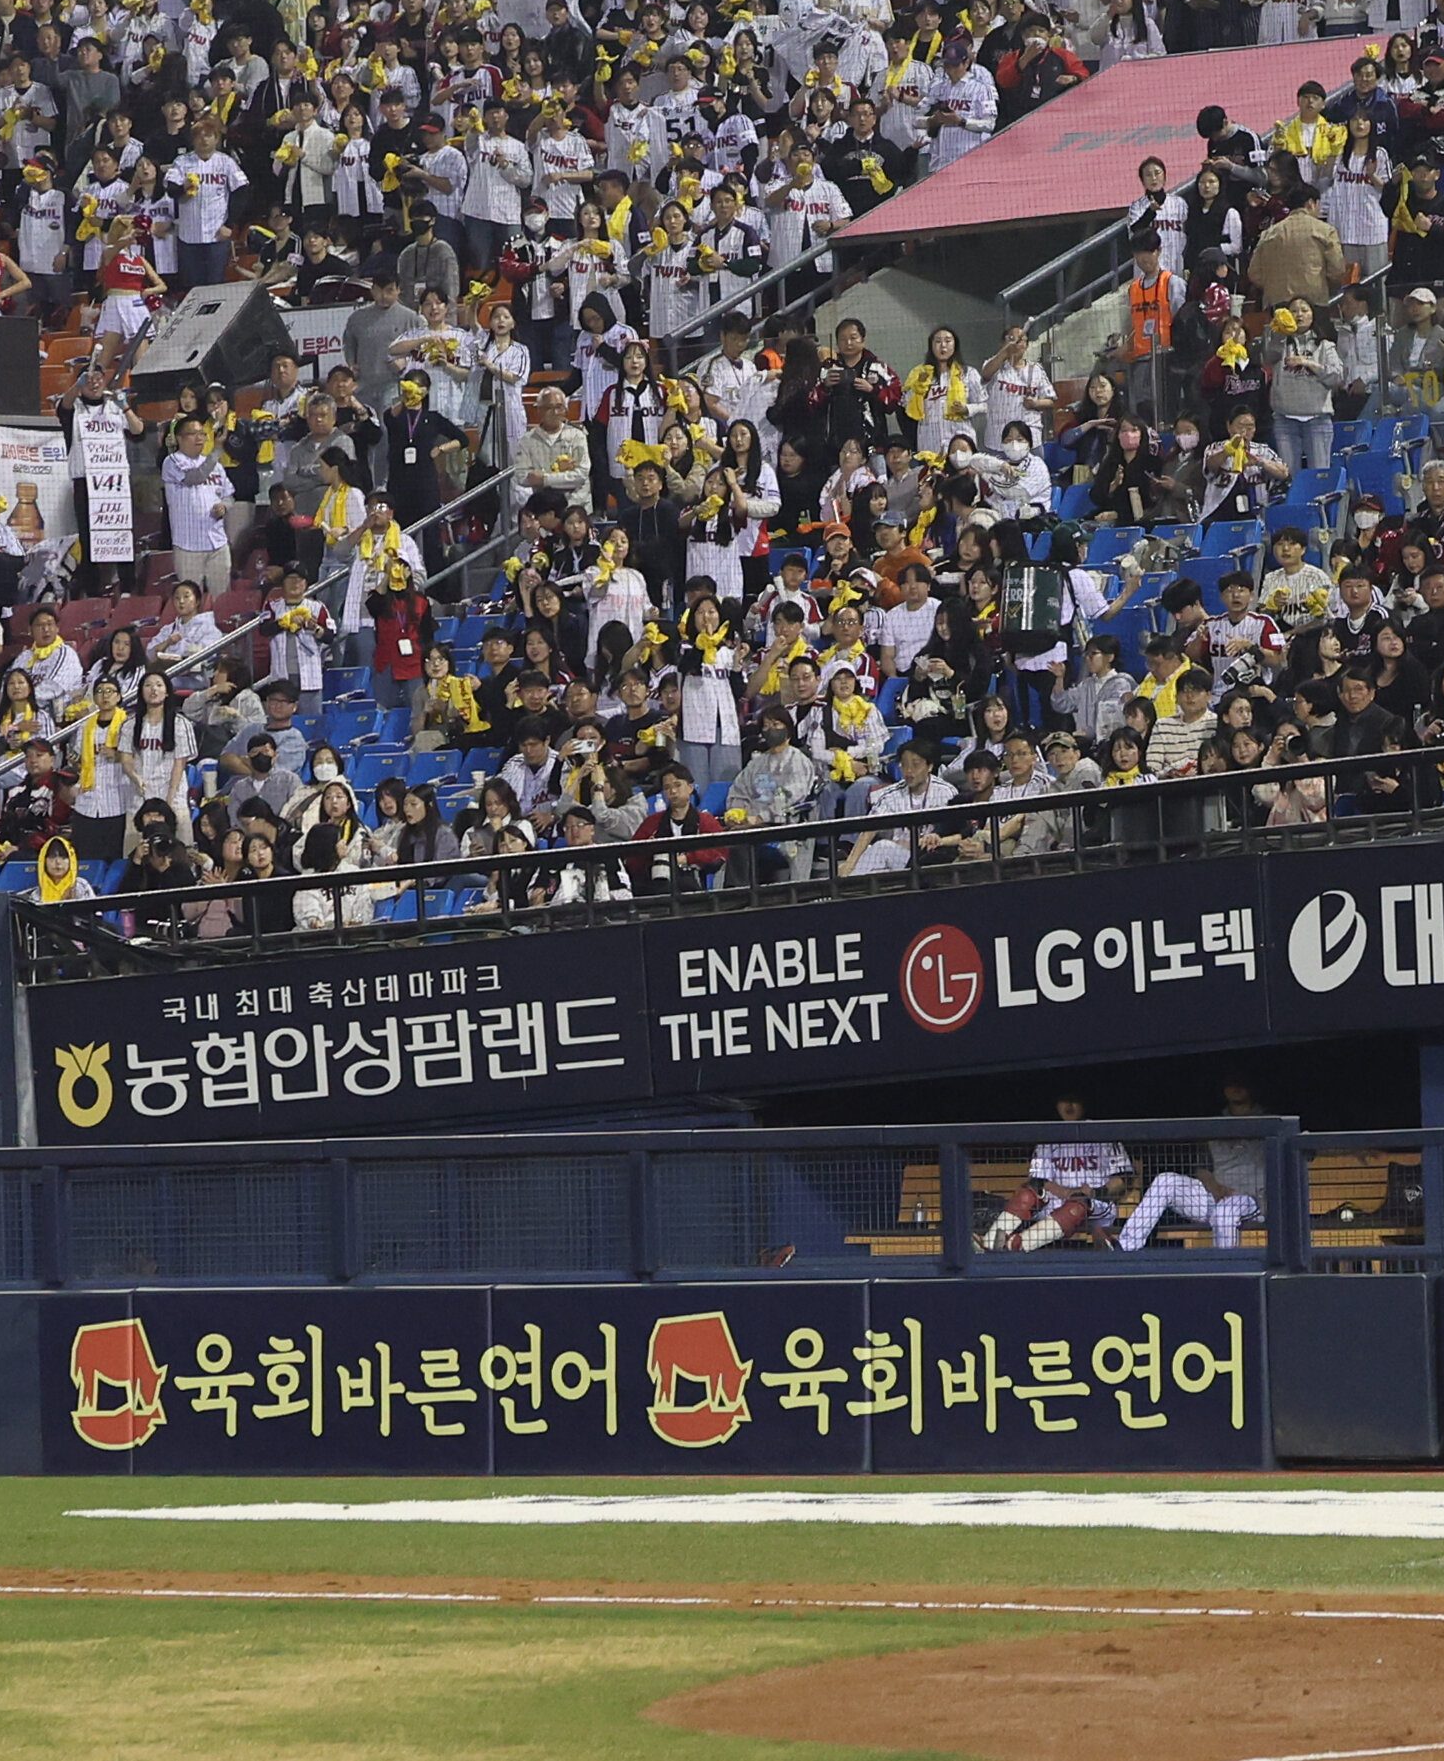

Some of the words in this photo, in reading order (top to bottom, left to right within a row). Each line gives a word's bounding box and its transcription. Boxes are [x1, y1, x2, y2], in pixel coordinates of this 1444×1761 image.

[540, 151, 577, 168] TWINS
[666, 117, 696, 141] 51
[998, 380, 1038, 396] TWINS
[92, 474, 122, 492] V4!
[678, 932, 863, 998] ENABLE
[994, 908, 1256, 1008] LG이노텍
[163, 993, 219, 1024] 국내
[236, 986, 293, 1017] 최대
[308, 965, 502, 1010] 축산테마파크
[660, 1008, 751, 1061] THE
[764, 993, 889, 1053] NEXT
[124, 996, 625, 1118] 농협안성팜랜드
[174, 1323, 618, 1437] 육회바른연어
[760, 1312, 1245, 1435] 육회바른연어
